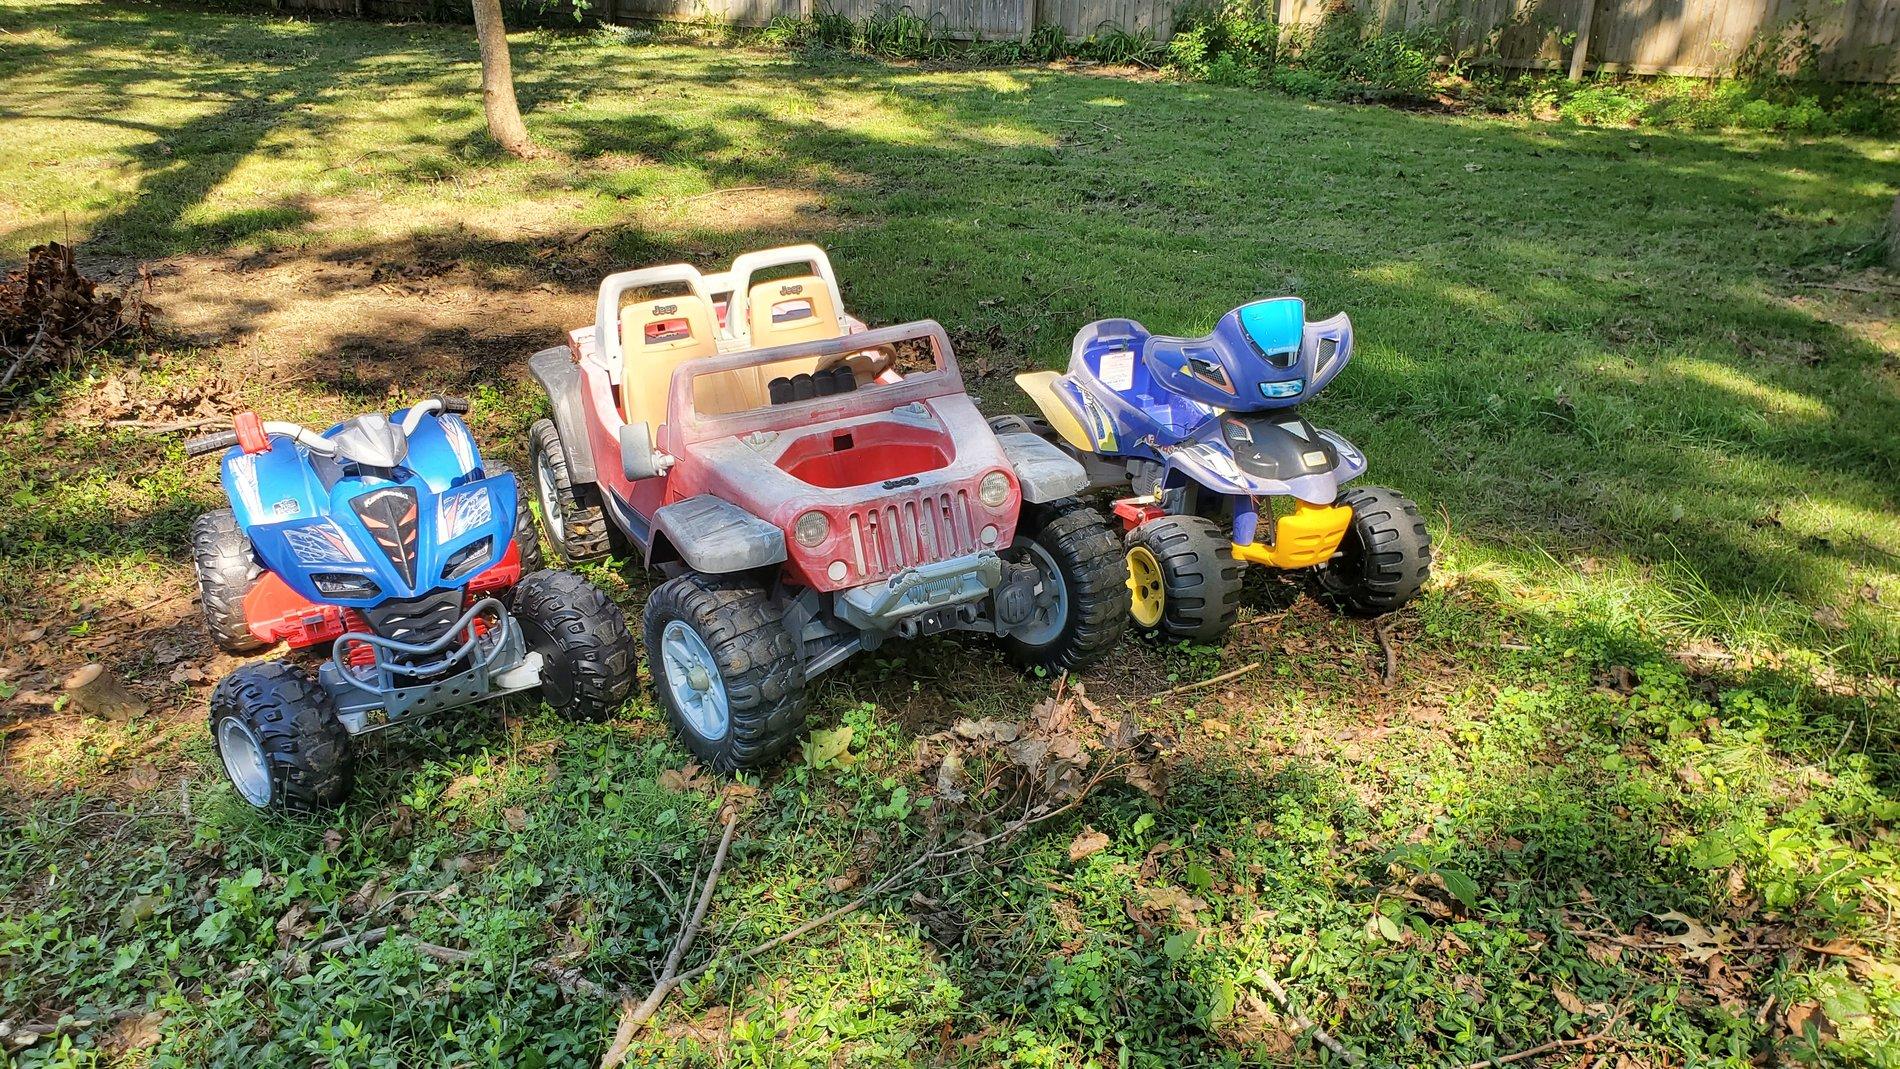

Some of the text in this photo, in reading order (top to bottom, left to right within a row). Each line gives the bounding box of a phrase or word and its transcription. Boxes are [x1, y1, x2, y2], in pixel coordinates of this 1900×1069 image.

[780, 285, 803, 296] Jeep
[652, 305, 677, 316] Jeep
[882, 477, 919, 490] Jeep
